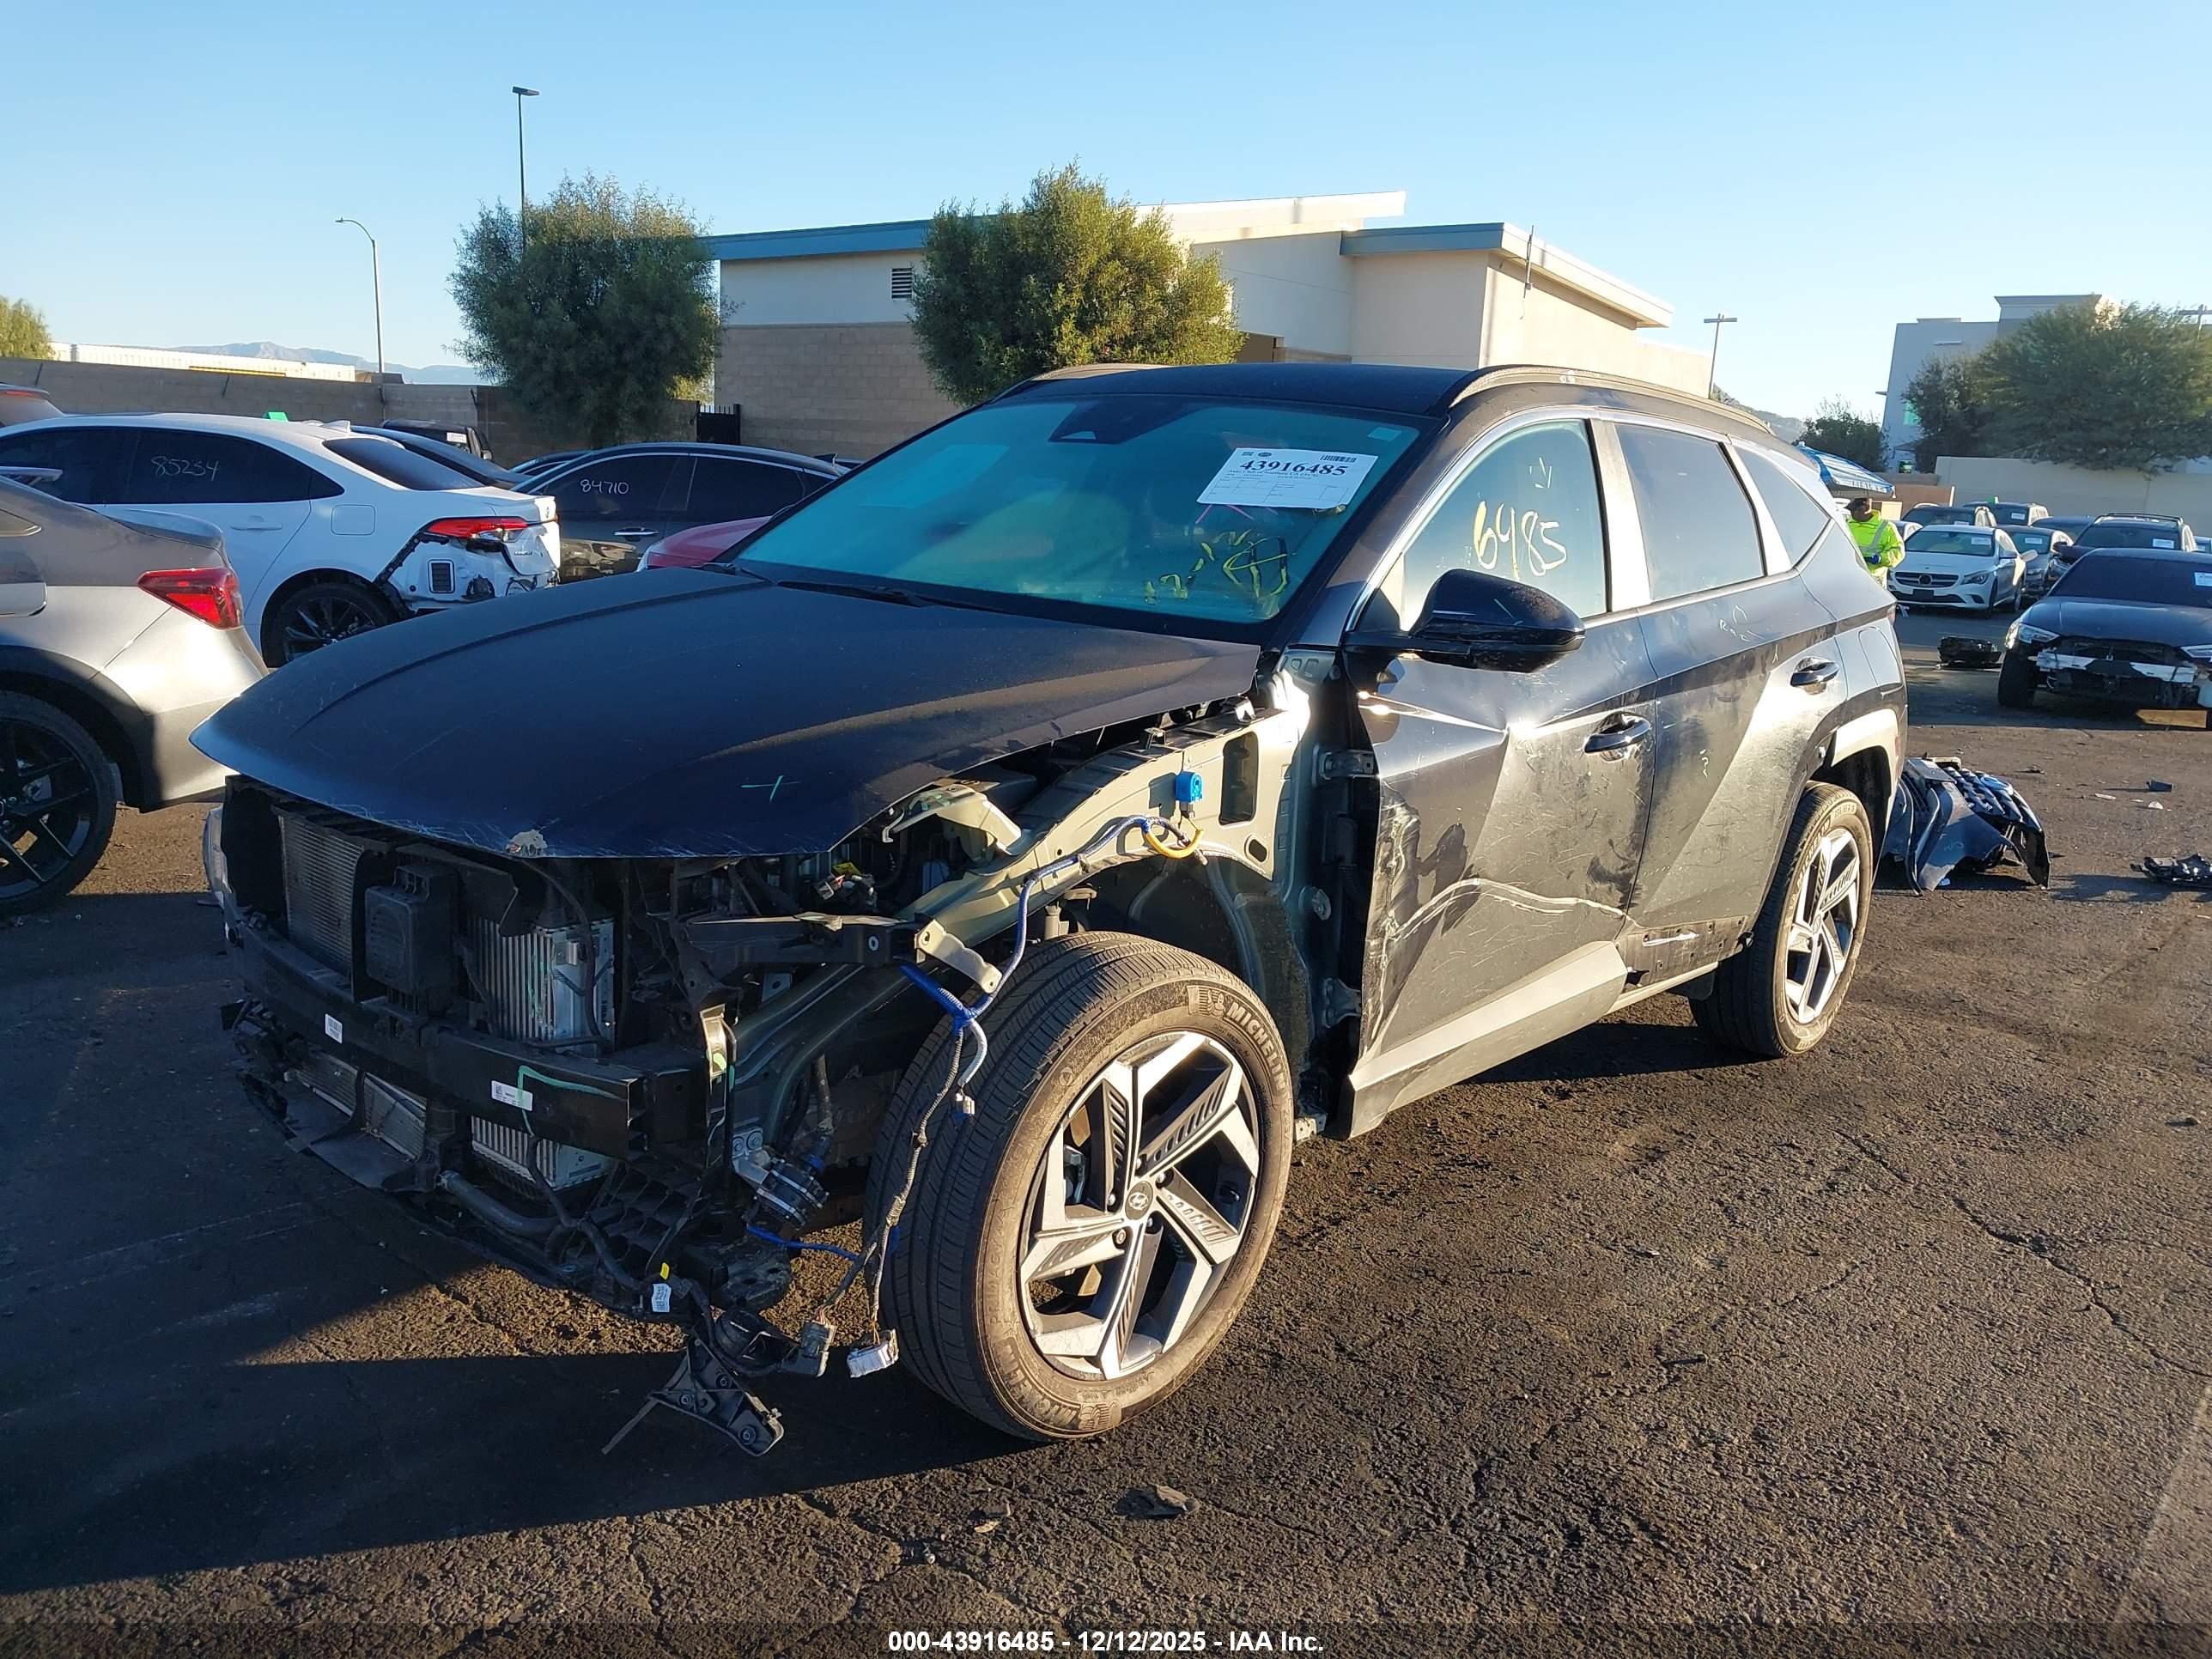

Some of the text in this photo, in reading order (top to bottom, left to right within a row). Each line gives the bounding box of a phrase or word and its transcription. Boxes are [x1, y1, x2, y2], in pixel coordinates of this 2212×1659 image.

[580, 478, 629, 495] 84710
[1239, 459, 1350, 477] 43916485
[1474, 501, 1567, 581] 6485
[1225, 1001, 1287, 1091] MICHELIN
